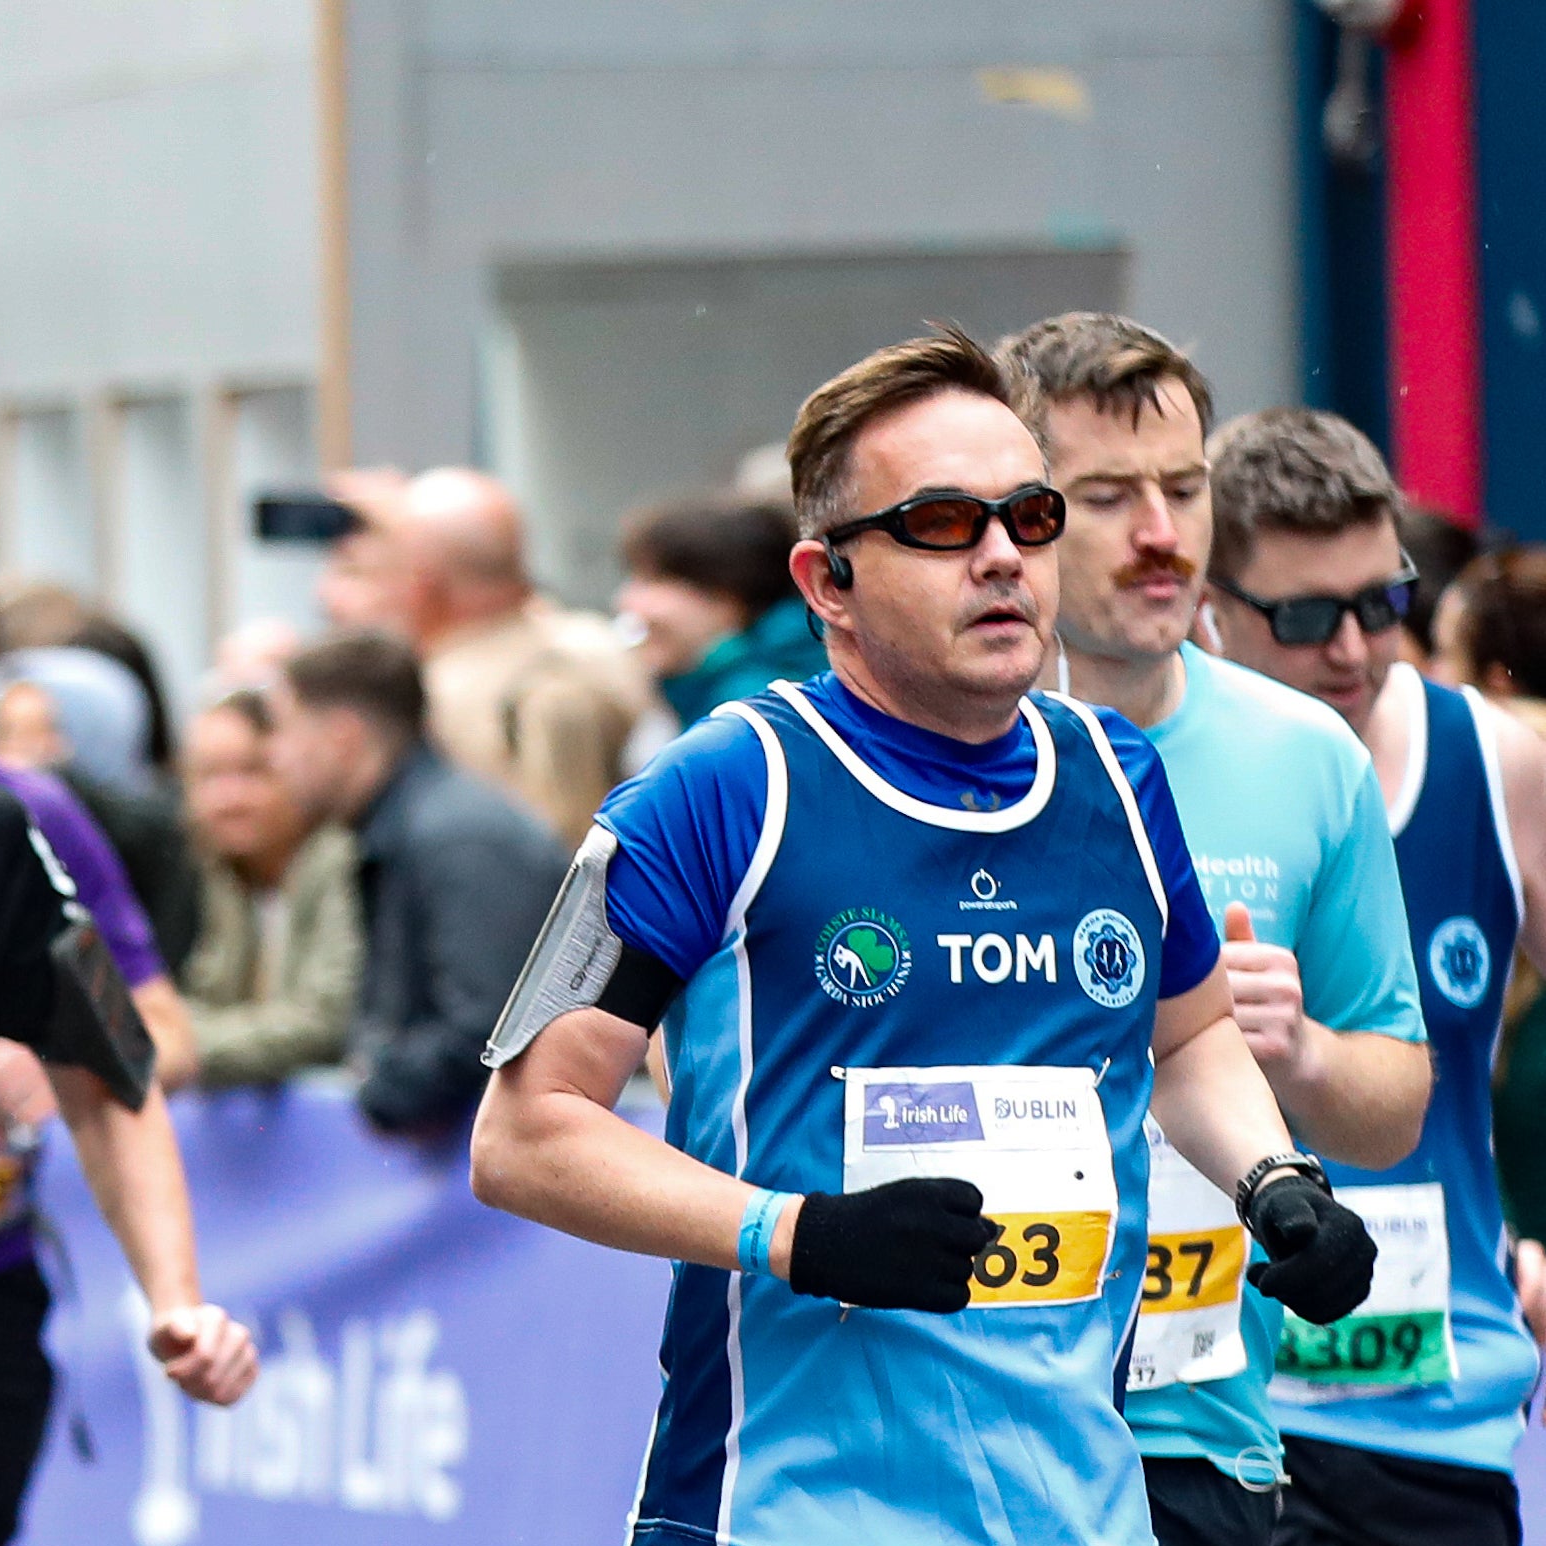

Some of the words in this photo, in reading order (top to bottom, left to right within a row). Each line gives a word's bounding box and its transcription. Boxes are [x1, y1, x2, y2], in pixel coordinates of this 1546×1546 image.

[1201, 879, 1279, 901] TION
[937, 933, 1057, 985] TOM
[901, 1103, 939, 1124] Irish
[940, 1104, 969, 1124] Life
[994, 1097, 1076, 1119] DUBLIN
[974, 1222, 1060, 1287] 63
